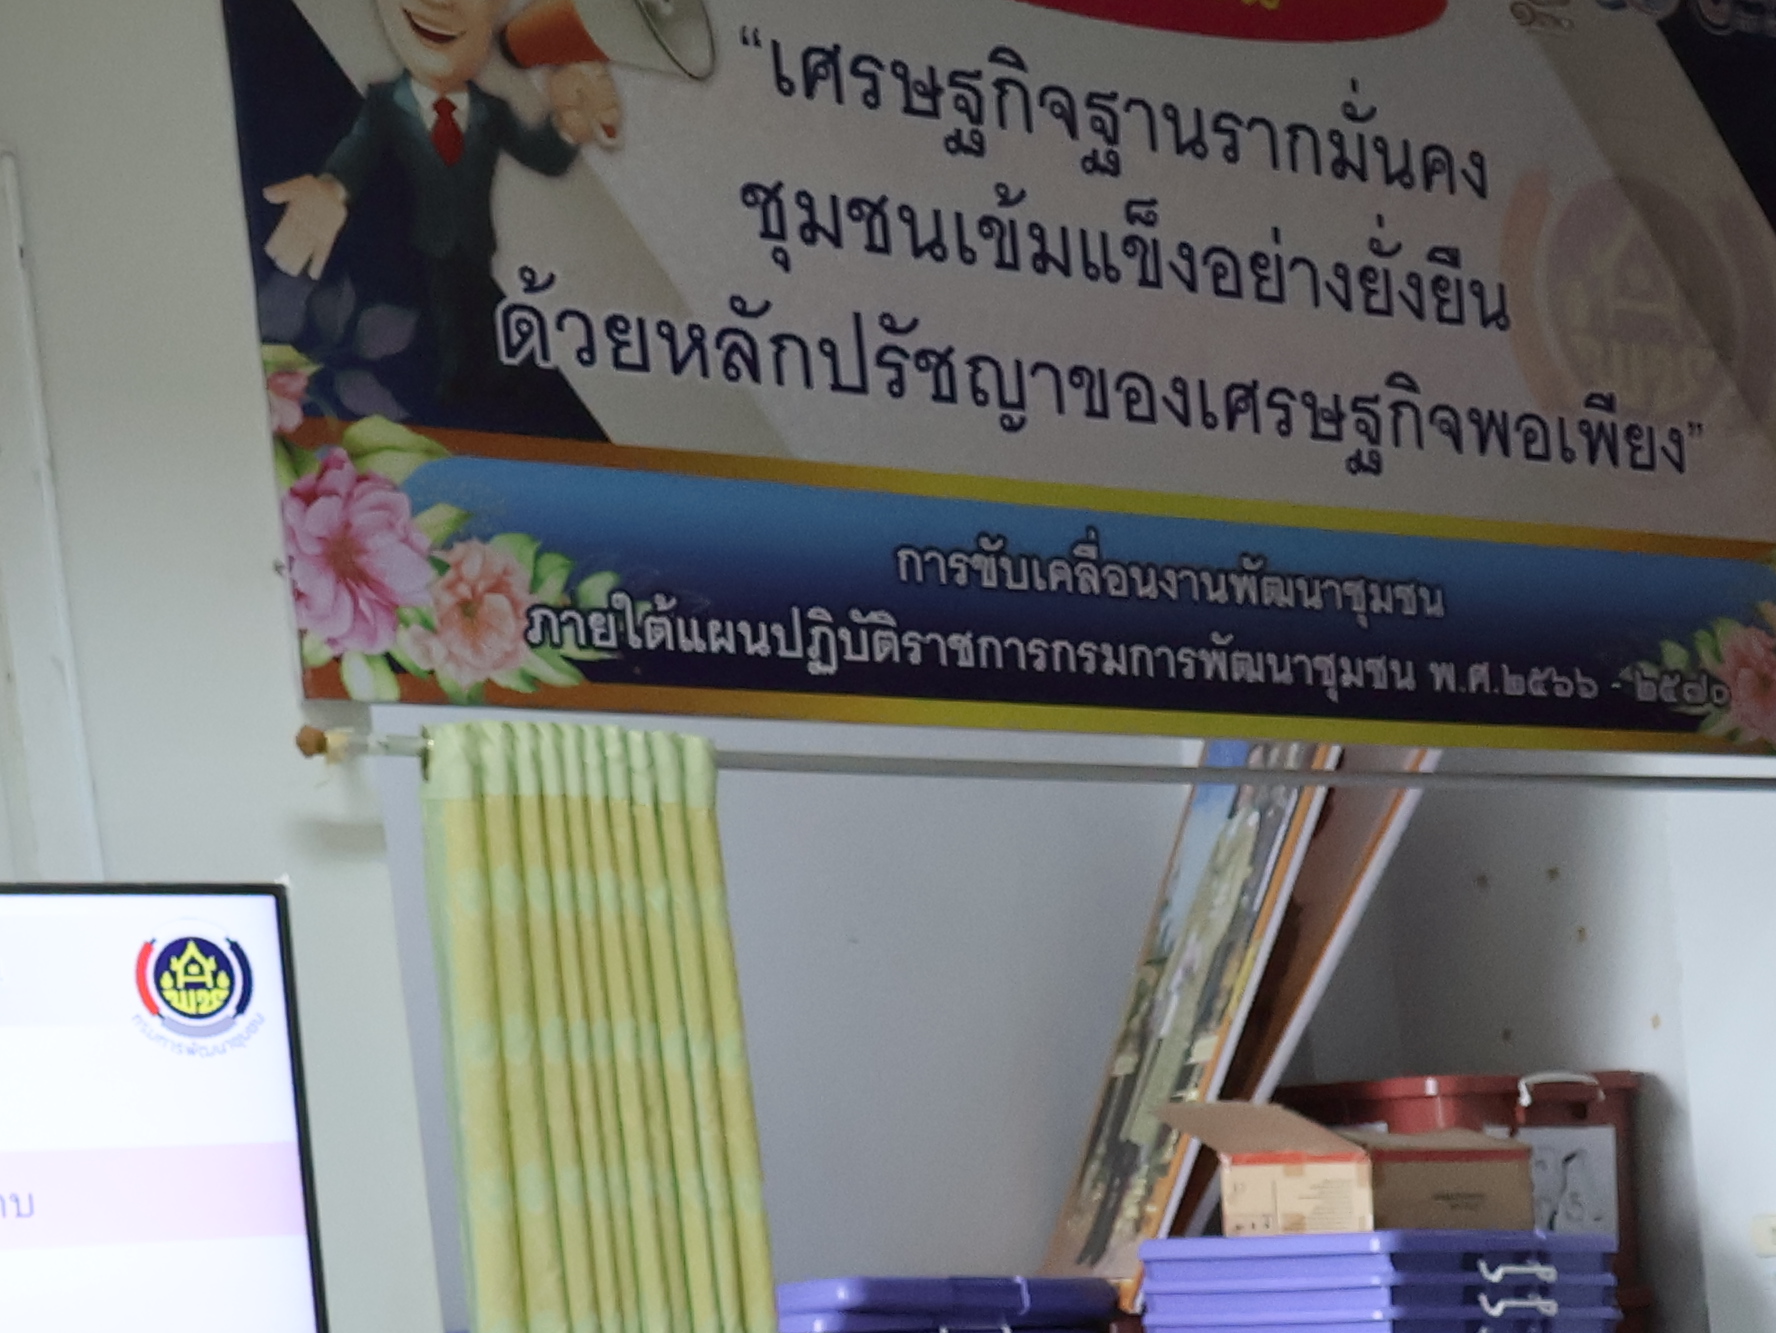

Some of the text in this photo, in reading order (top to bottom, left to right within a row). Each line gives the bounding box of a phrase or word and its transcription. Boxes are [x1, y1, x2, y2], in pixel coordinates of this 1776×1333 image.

[739, 26, 1489, 199] “เศรษฐกิจฐานรากมั่นคง
[739, 180, 1510, 332] ชุมชนเข้มแข็งอย่างยั่งยืน
[497, 266, 1703, 476] ด้วยหลักปรัชญาของเศรษฐกิจพอเพียง”
[526, 595, 1416, 703] ภายใต้แผนปฏิบัติราชการกรมการพัฒนาชุมชน
[896, 526, 1445, 628] การขับเคลื่อนงานพัฒนาชุมชน
